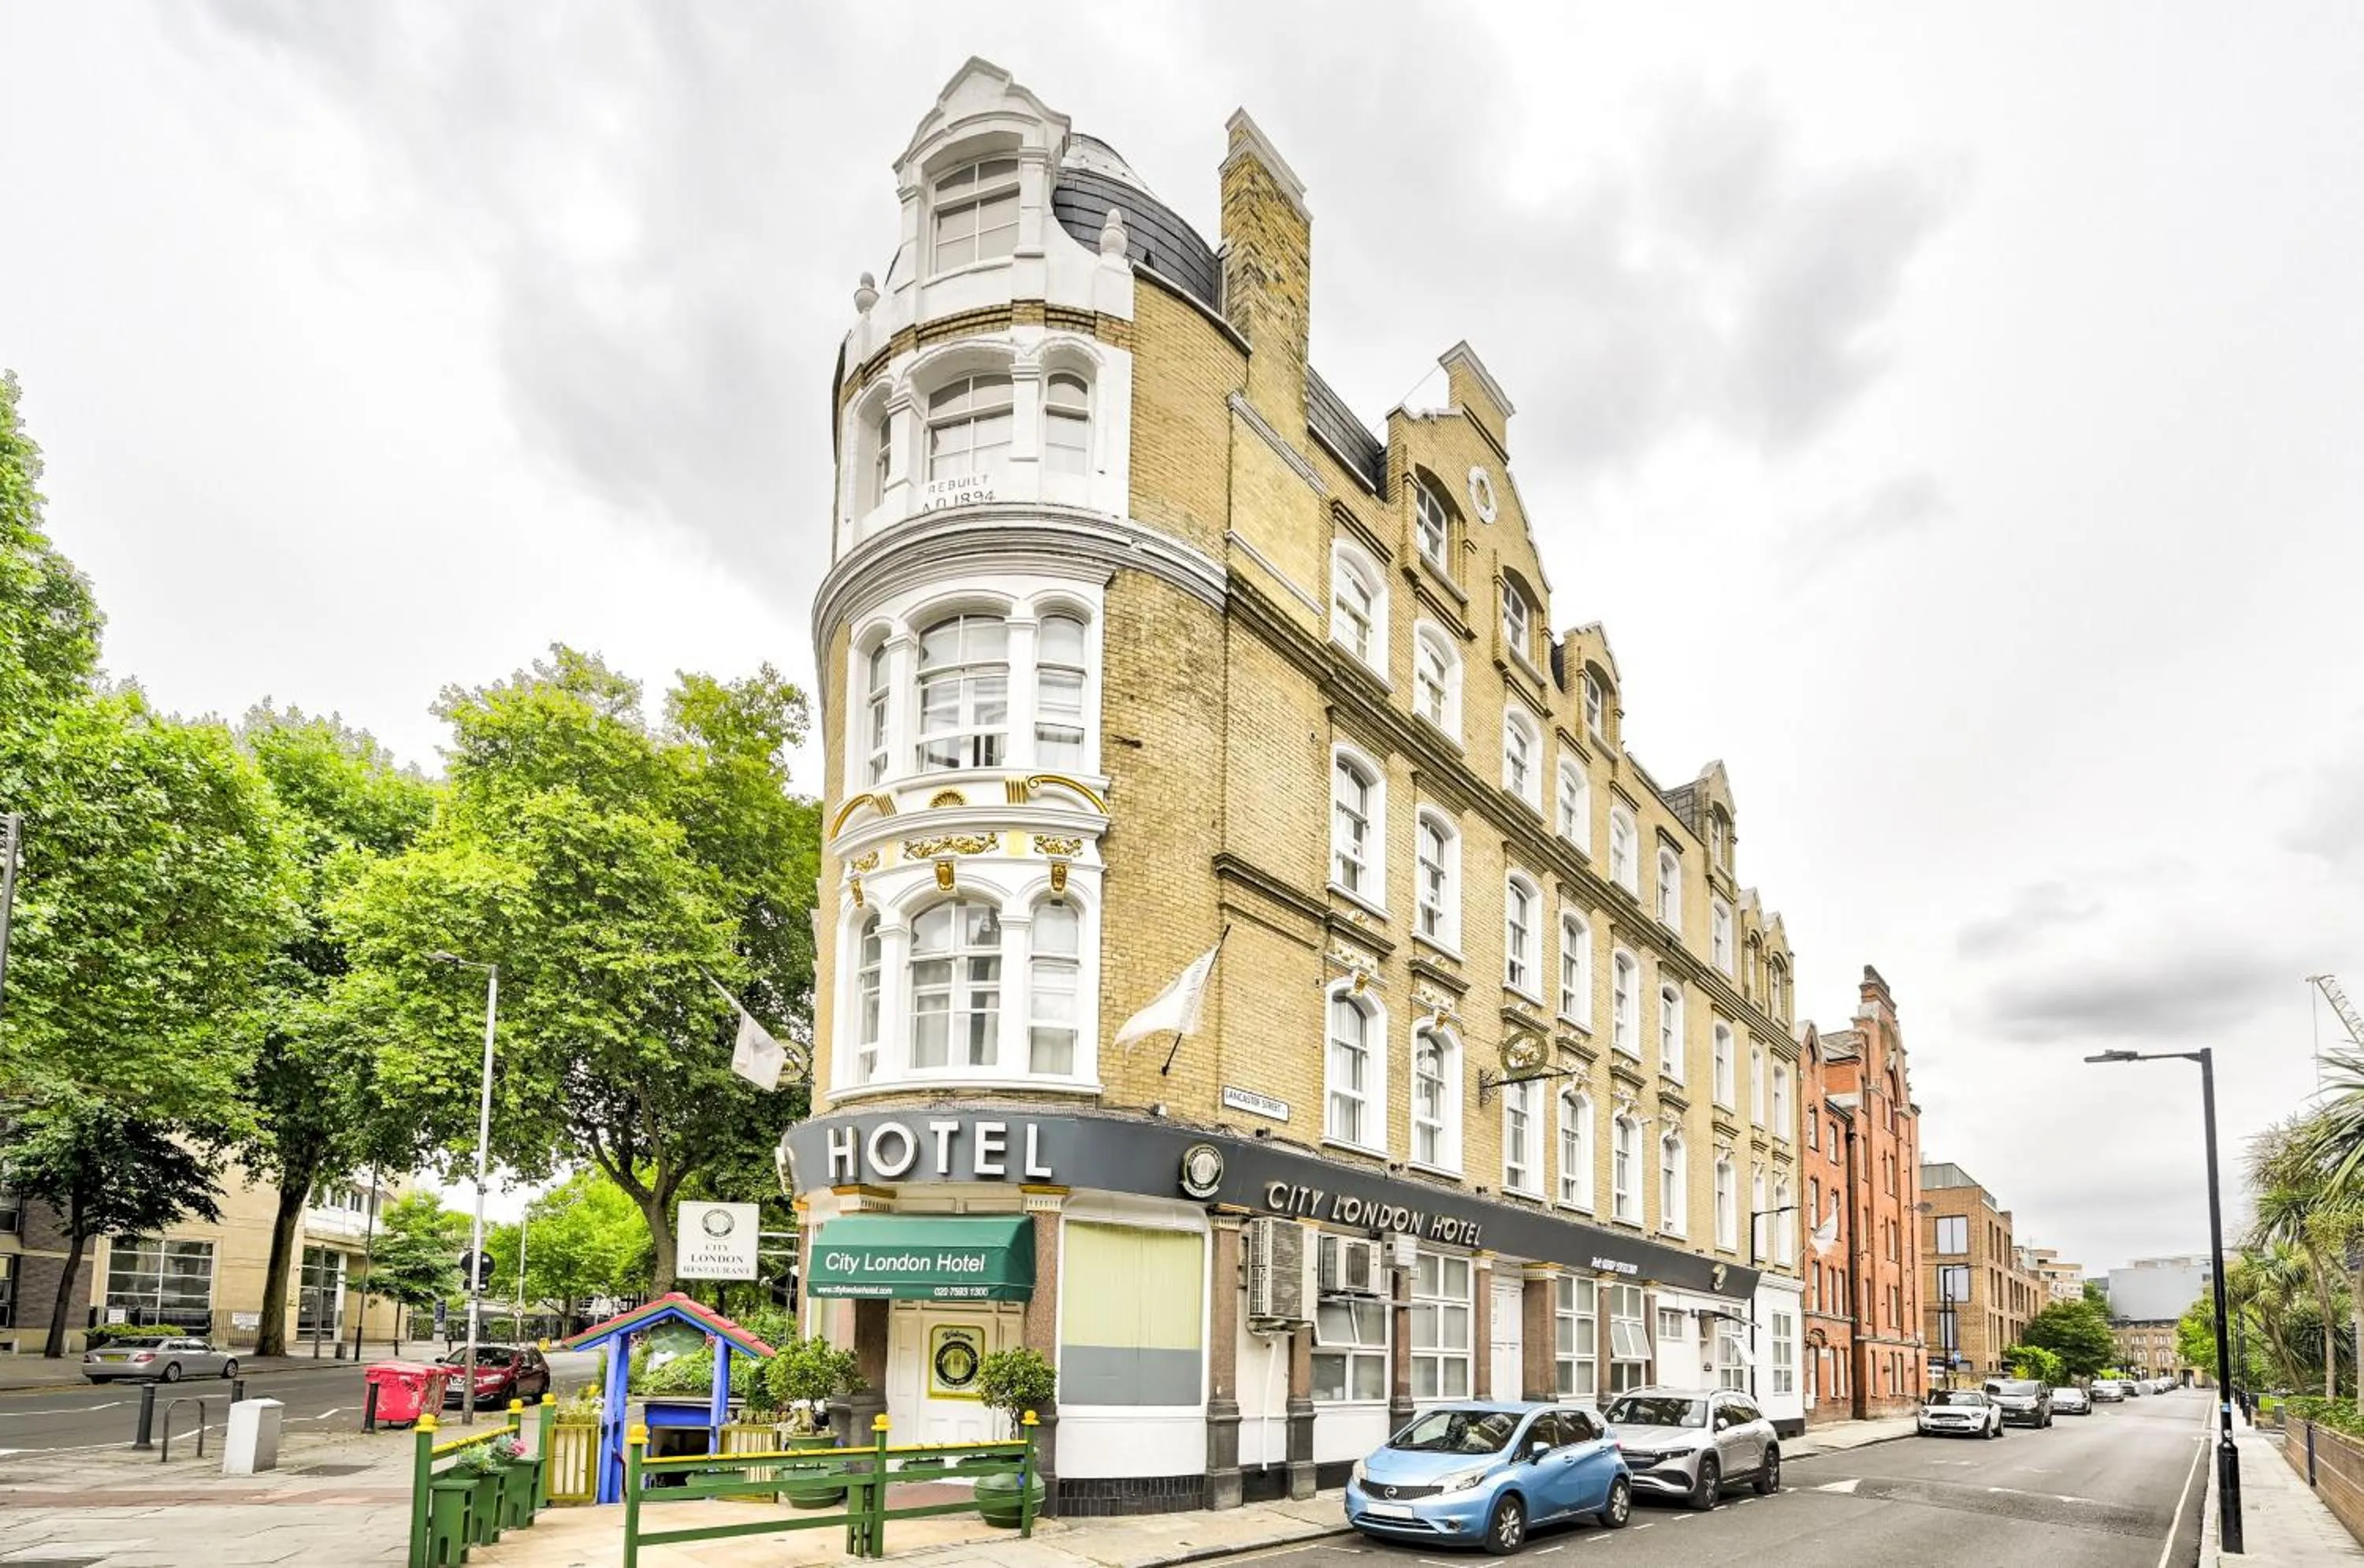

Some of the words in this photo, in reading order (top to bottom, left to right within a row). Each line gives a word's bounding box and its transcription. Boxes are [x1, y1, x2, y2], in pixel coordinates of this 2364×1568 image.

[928, 474, 988, 493] REBUILT
[953, 489, 994, 506] 1894
[827, 1120, 1053, 1180] HOTEL
[1268, 1182, 1324, 1216] CITY
[1332, 1195, 1425, 1234] LONDON
[1430, 1214, 1482, 1246] HOTEL
[691, 1254, 743, 1264] LONDON
[825, 1252, 859, 1274] City
[864, 1253, 931, 1272] London
[936, 1254, 986, 1273] Hotel
[683, 1265, 750, 1274] RESTAURANT
